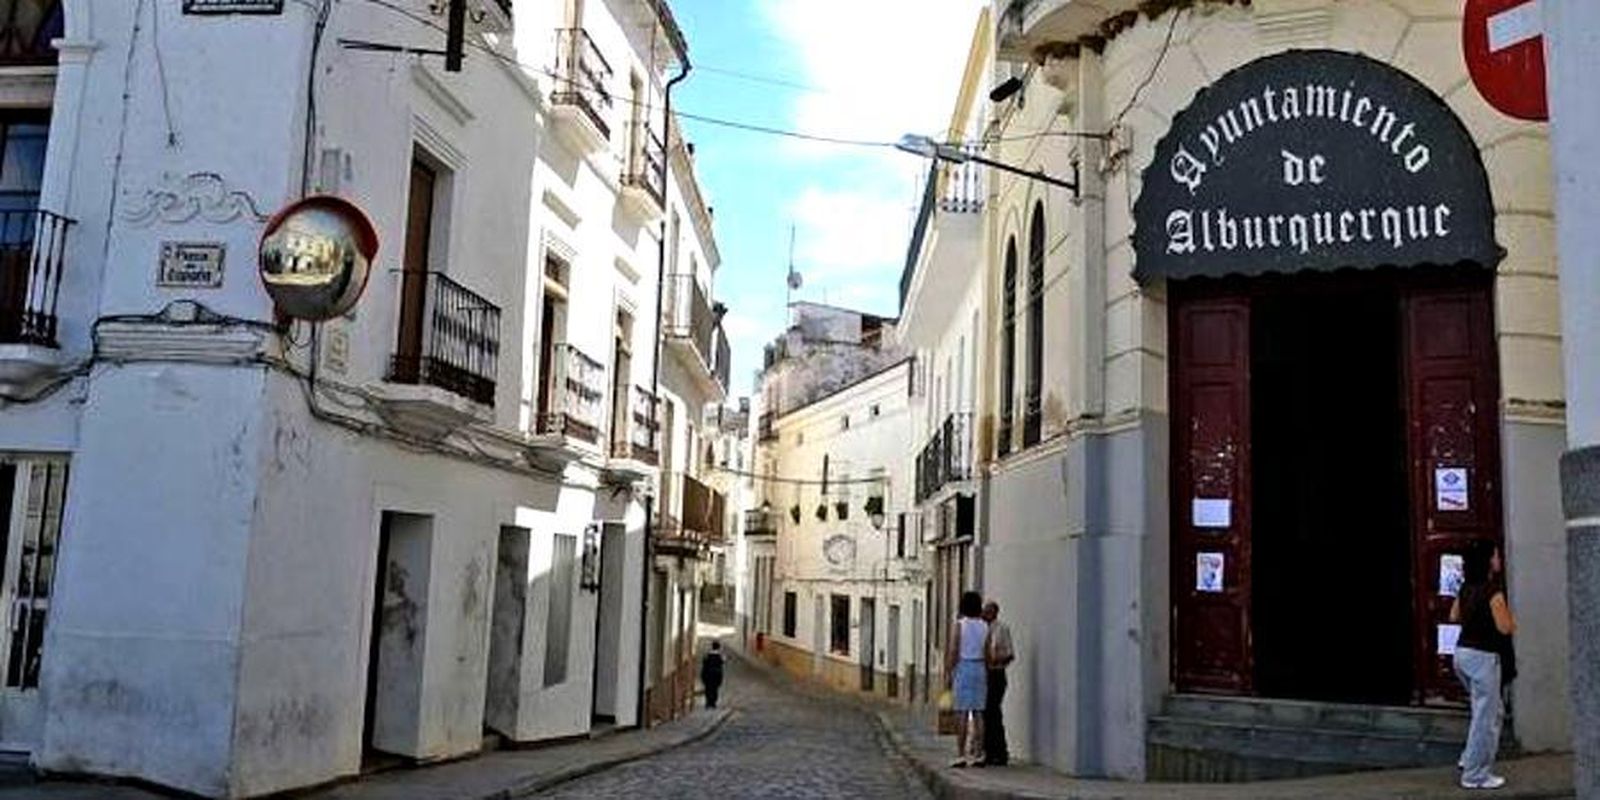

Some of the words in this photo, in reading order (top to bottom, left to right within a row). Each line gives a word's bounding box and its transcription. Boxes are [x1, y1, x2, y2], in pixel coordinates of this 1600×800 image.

[1170, 81, 1430, 196] Ayuntamiento
[1281, 149, 1326, 186] de
[1165, 203, 1451, 254] Alburquerque
